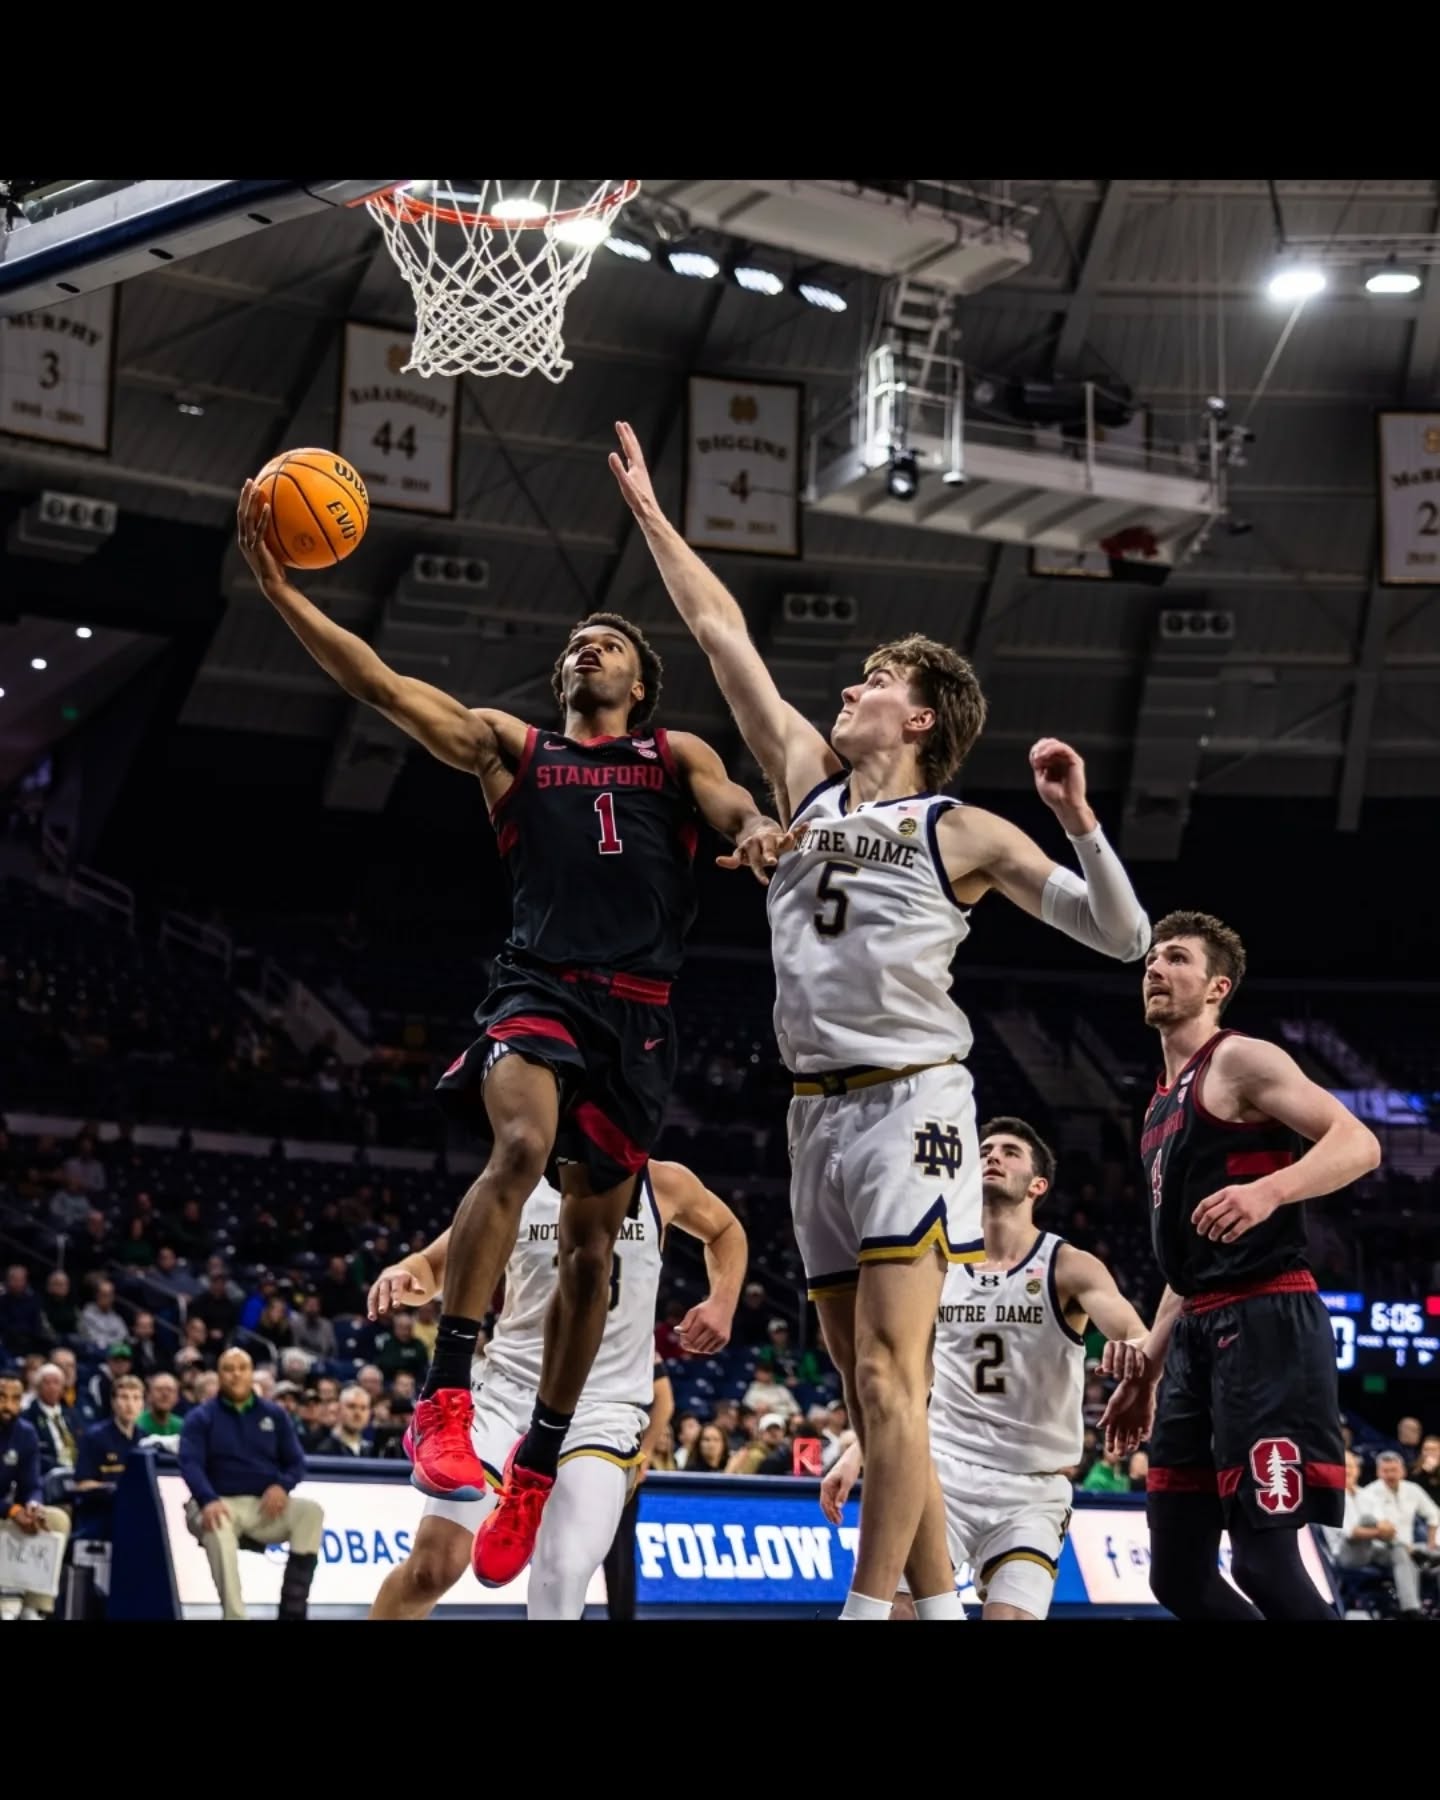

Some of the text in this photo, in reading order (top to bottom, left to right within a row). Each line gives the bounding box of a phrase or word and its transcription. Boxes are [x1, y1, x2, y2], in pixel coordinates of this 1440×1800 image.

[39, 350, 60, 390] 3
[371, 420, 418, 461] 44
[729, 469, 748, 504] 4
[535, 764, 665, 791] STANFORD
[594, 791, 623, 855] 1
[854, 835, 918, 870] DAME
[814, 859, 862, 938] 5
[528, 1223, 560, 1242] NOT
[937, 1304, 1044, 1326] NOTRE DAME
[1370, 1301, 1424, 1334] 6:06
[974, 1331, 1006, 1395] 2
[321, 1529, 411, 1564] DBAS
[635, 1522, 834, 1580] FOLLOW
